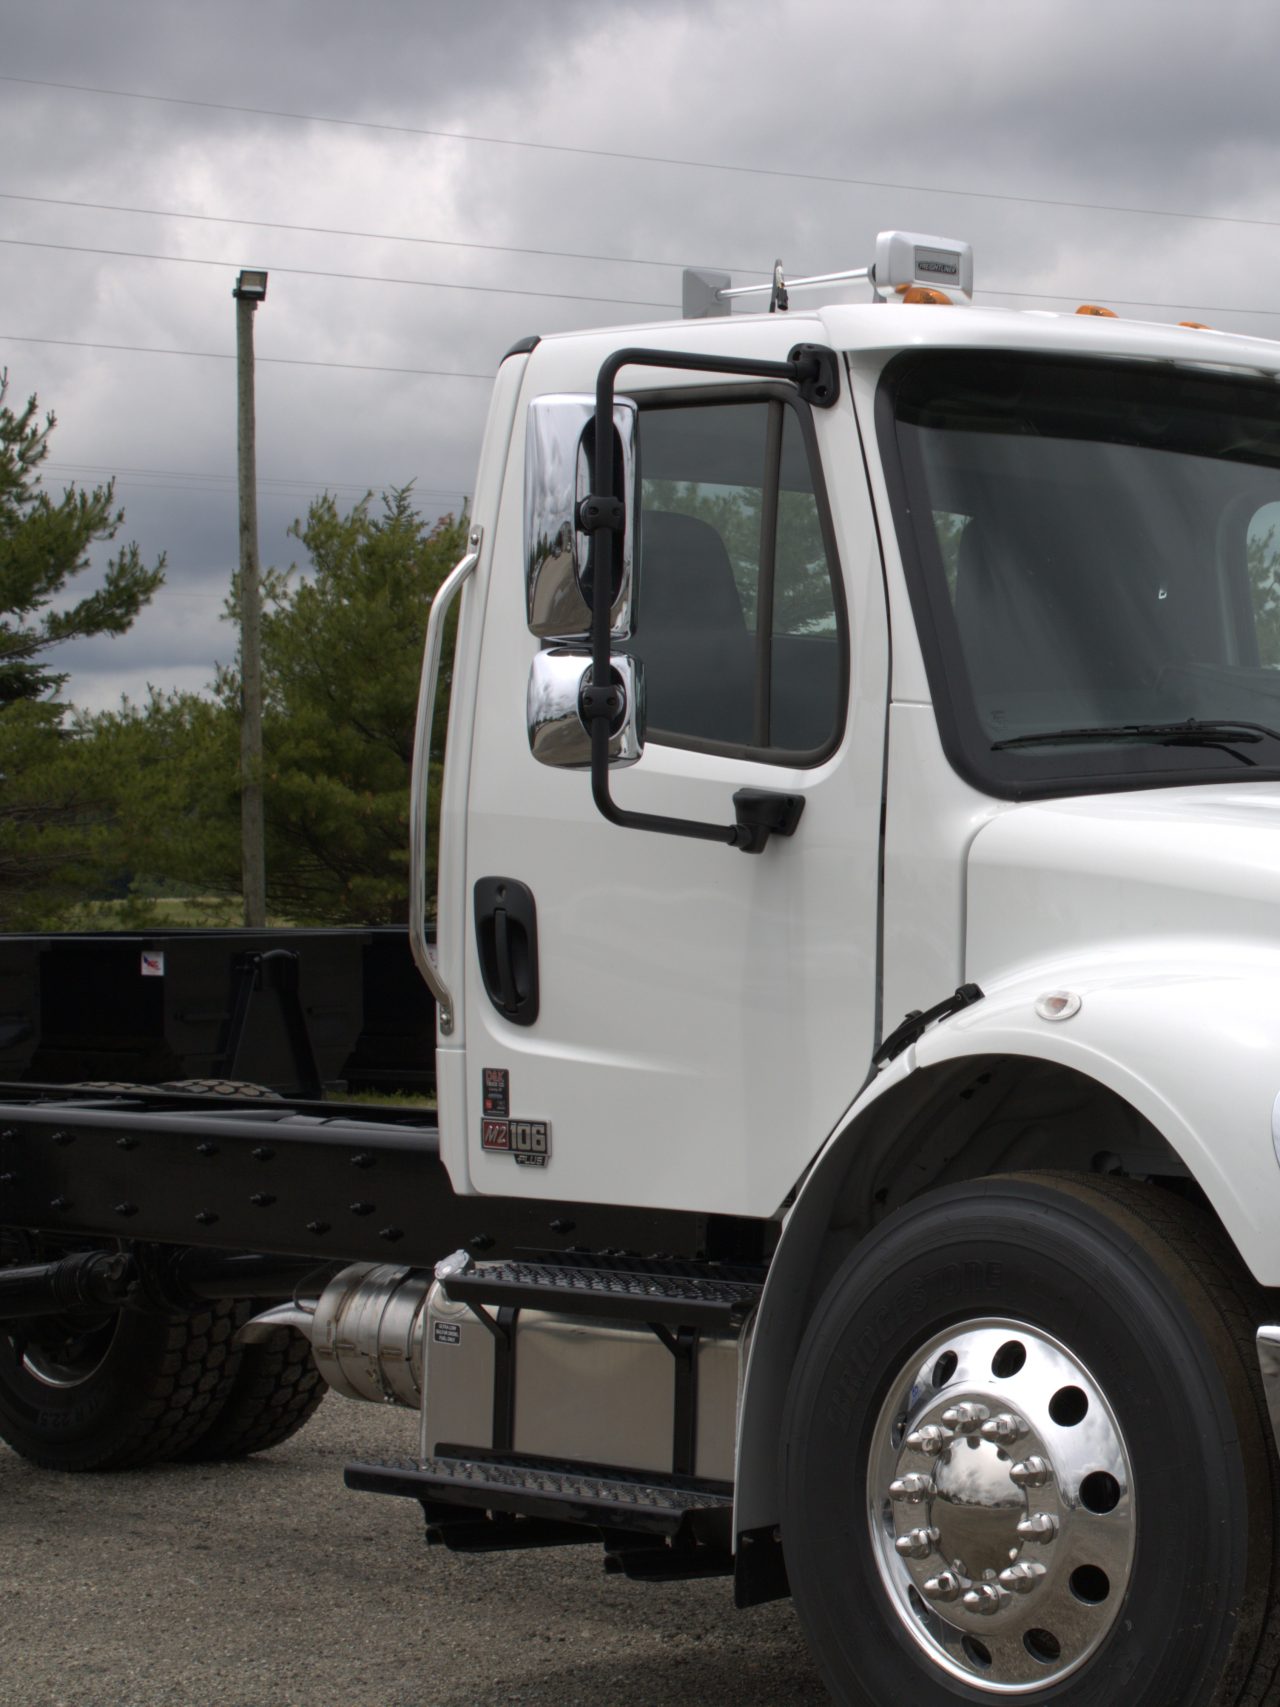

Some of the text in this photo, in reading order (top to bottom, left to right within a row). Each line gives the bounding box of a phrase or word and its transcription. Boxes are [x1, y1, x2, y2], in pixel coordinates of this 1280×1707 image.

[918, 262, 957, 273] FREIGHTLINER
[485, 1122, 546, 1152] M2 106
[517, 1155, 543, 1165] PLUS
